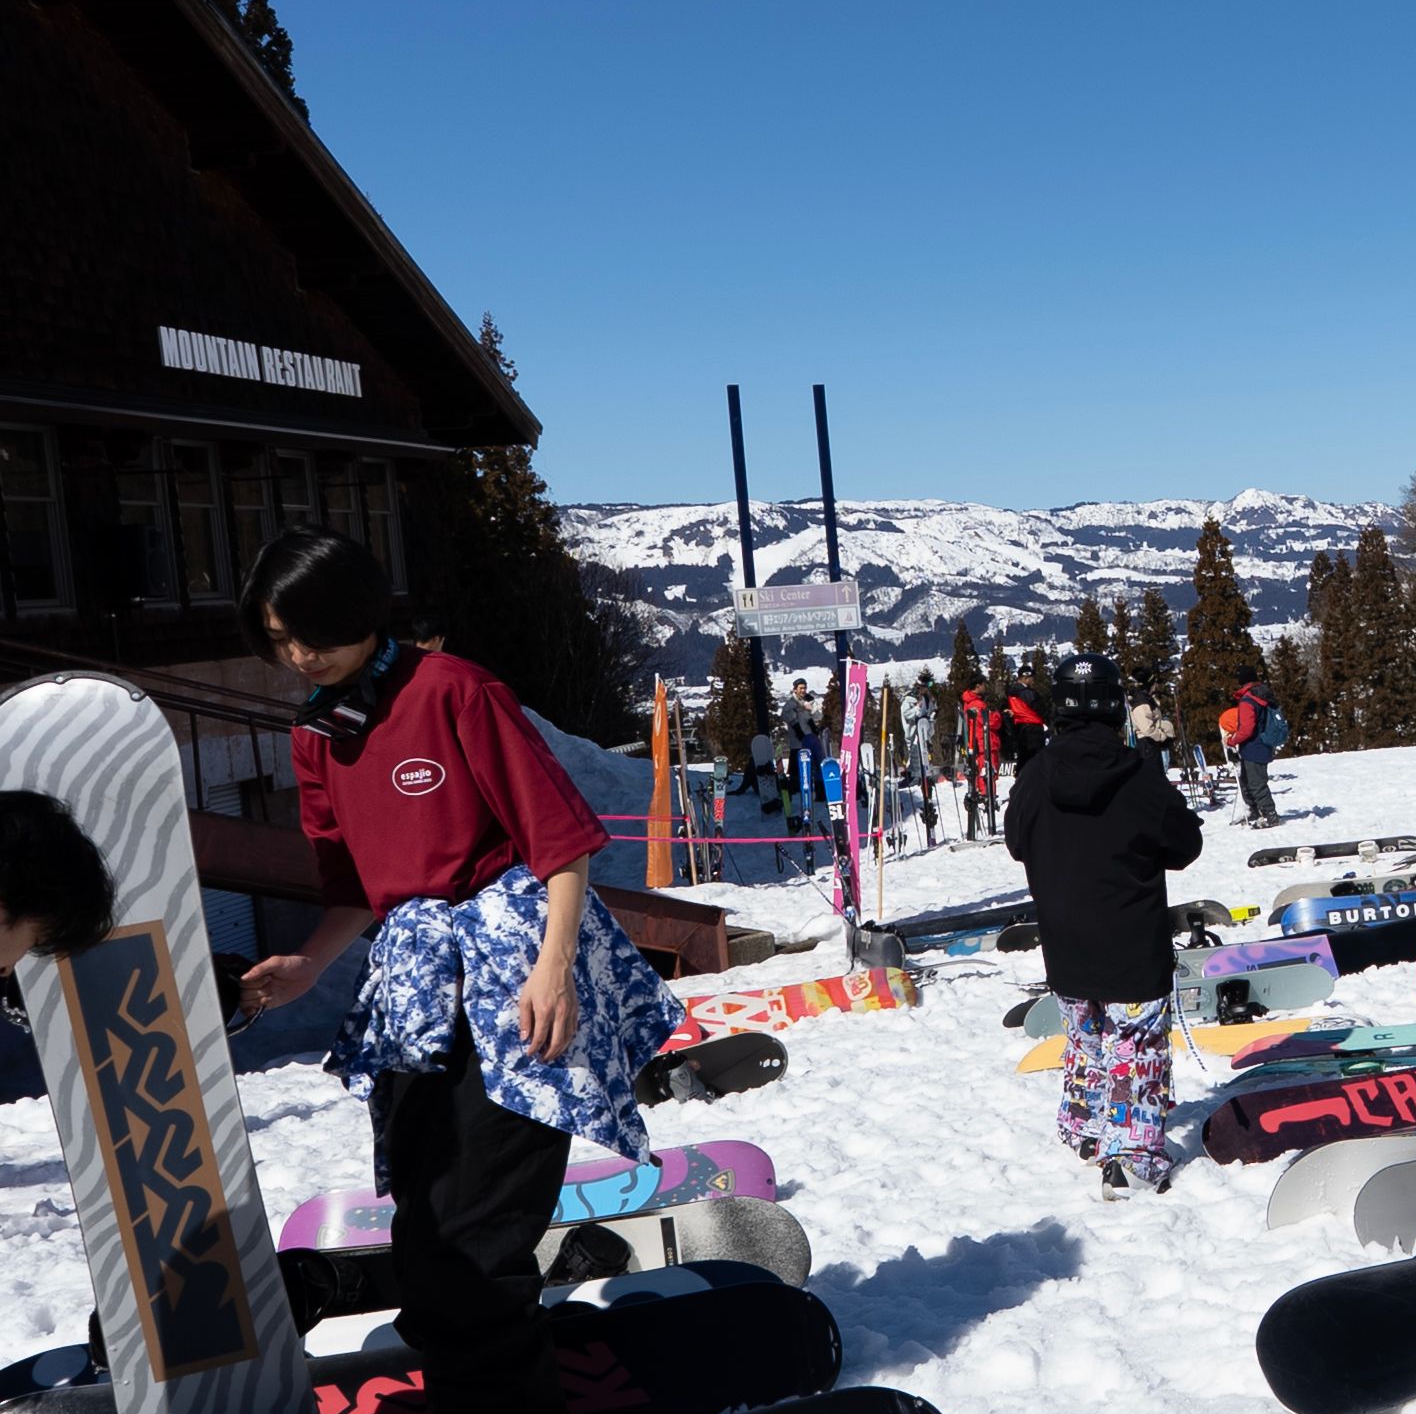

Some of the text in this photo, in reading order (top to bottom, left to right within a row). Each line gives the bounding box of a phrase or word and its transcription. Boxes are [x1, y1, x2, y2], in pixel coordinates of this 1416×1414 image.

[157, 325, 363, 398] MOUNTAIN RESTAURANT
[760, 589, 811, 602] Ski Center
